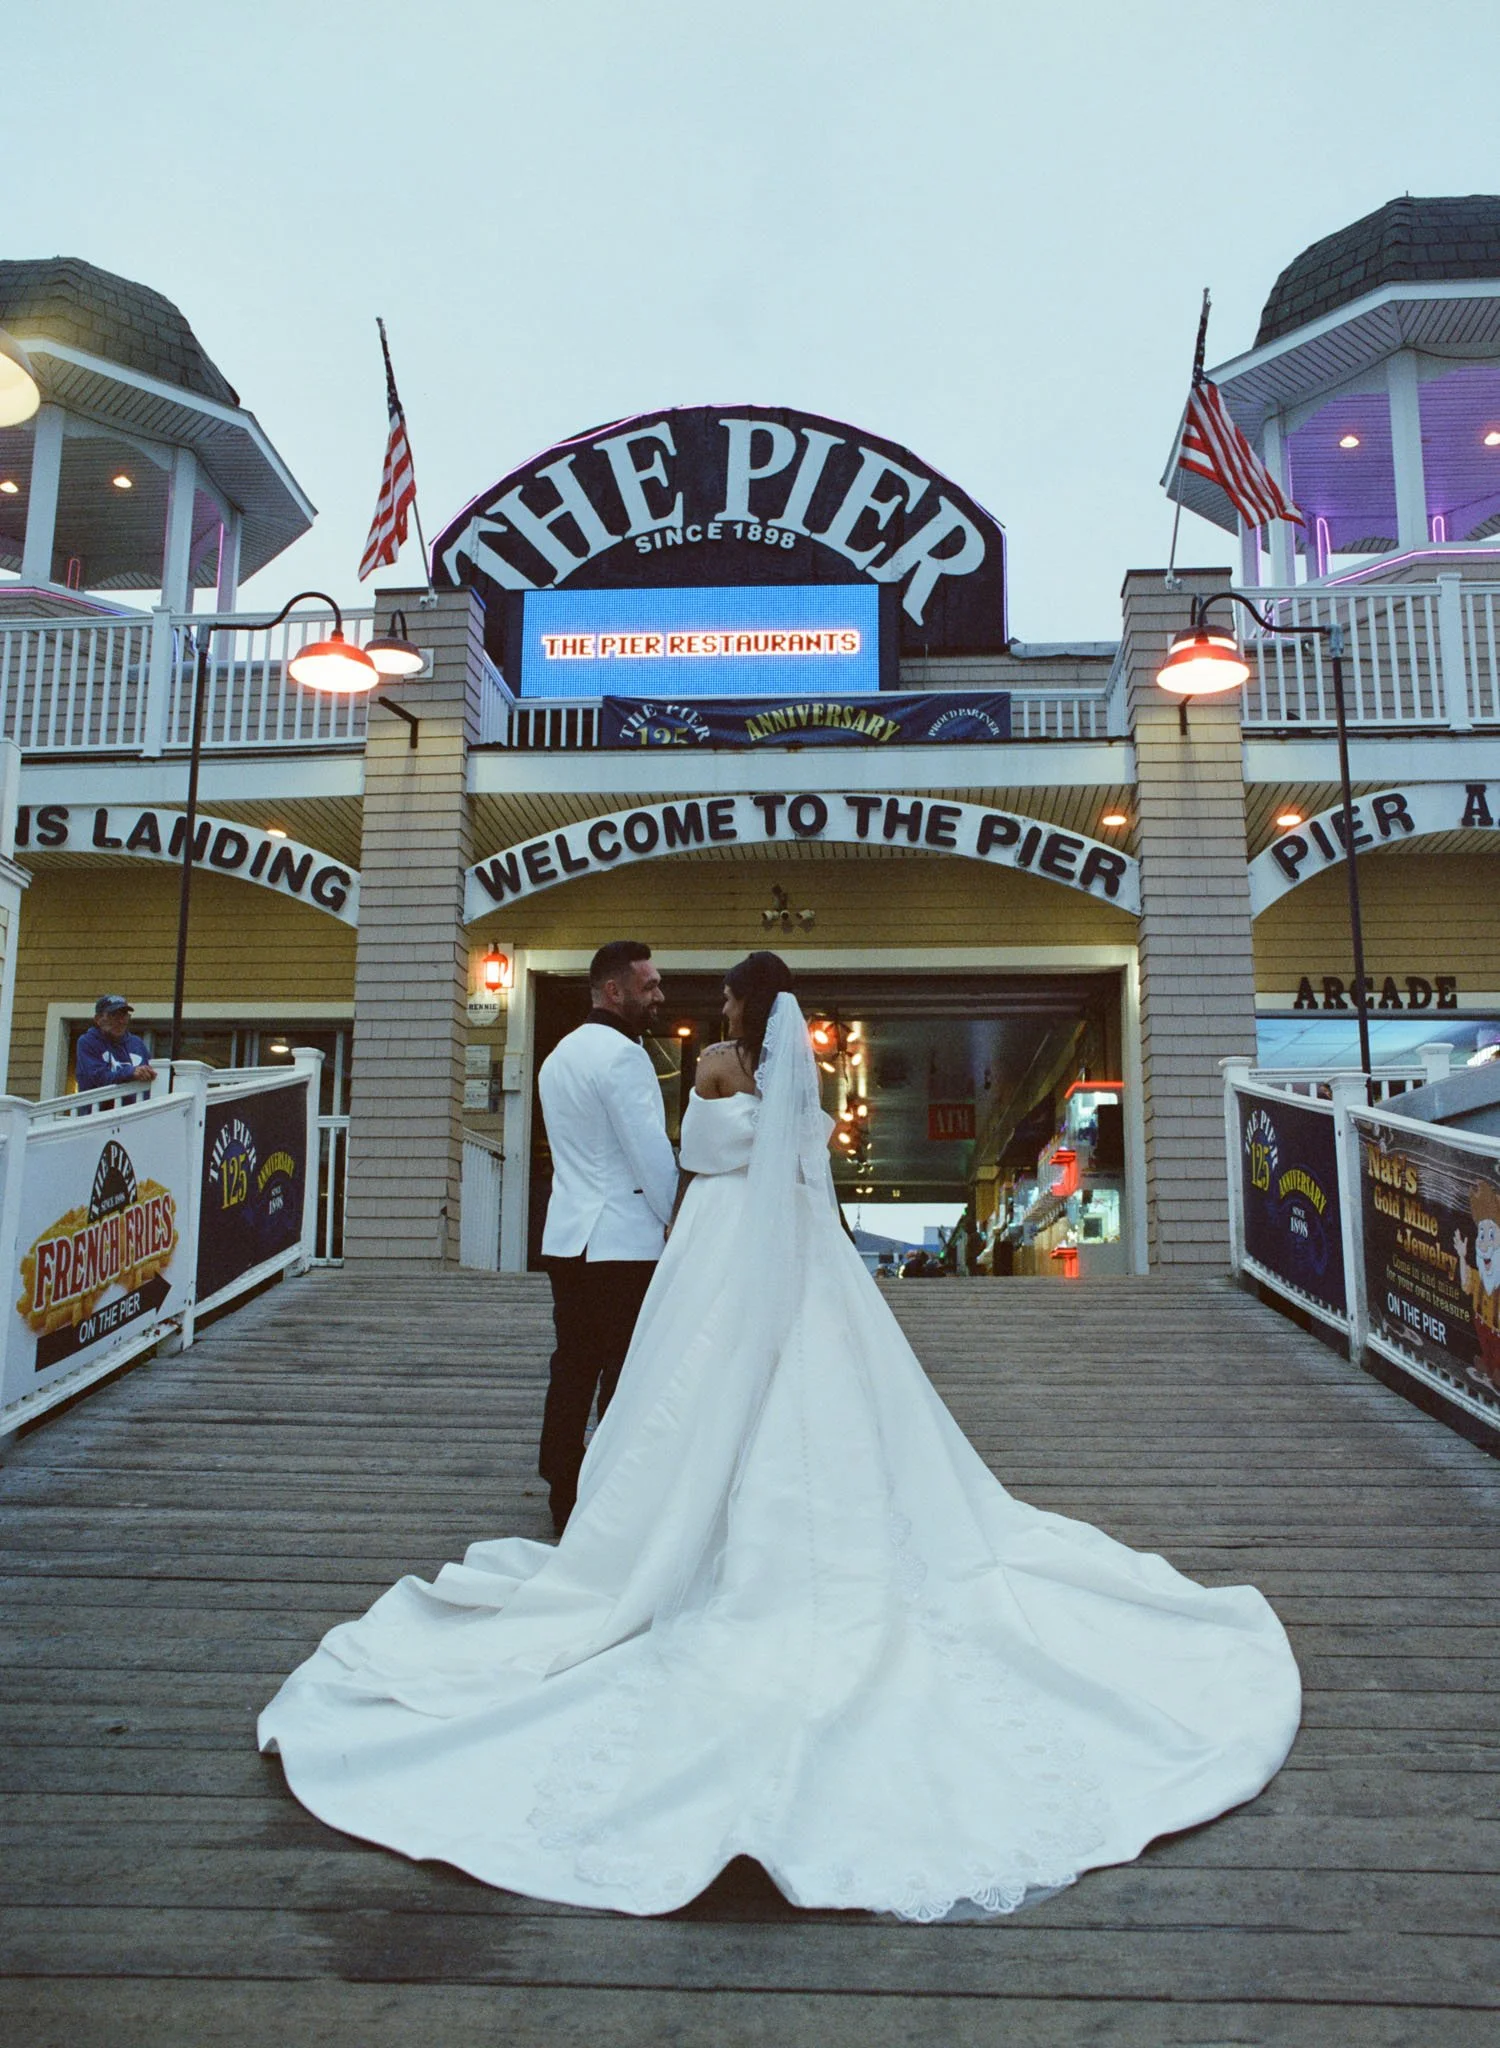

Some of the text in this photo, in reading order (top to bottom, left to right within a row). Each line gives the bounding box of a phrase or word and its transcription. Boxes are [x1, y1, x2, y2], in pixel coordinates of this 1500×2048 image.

[442, 418, 986, 627] THE PIER
[635, 520, 796, 554] SINCE 1898
[545, 633, 857, 657] THE PIER RESTAURANTS
[619, 703, 710, 742] THE PIER
[744, 703, 901, 742] ANNIVERSARY
[928, 707, 1000, 737] PROUD PARTNER
[474, 794, 1127, 901] WELCOME TO THE PIER
[1271, 784, 1500, 881] PIER A
[92, 807, 352, 911] LANDING
[1293, 976, 1458, 1010] ARCADE
[209, 1119, 256, 1183] THE PIER
[1245, 1109, 1278, 1170] THE PIER
[110, 1144, 137, 1205] PIER
[221, 1153, 248, 1209] 125
[1251, 1142, 1269, 1191] 125
[1279, 1169, 1327, 1215] ANNIVERSARY
[1366, 1142, 1418, 1194] Nat's
[1374, 1184, 1438, 1237] Gold Mine
[33, 1193, 174, 1311] FRENCH FRIES
[1393, 1254, 1411, 1276] Come
[1412, 1263, 1420, 1280] in
[1438, 1280, 1459, 1300] mine
[1404, 1229, 1458, 1281] Jewelry
[78, 1292, 141, 1344] ON THE PIER
[1386, 1264, 1470, 1322] for your own treasure
[1387, 1292, 1447, 1345] ON THE PIER
